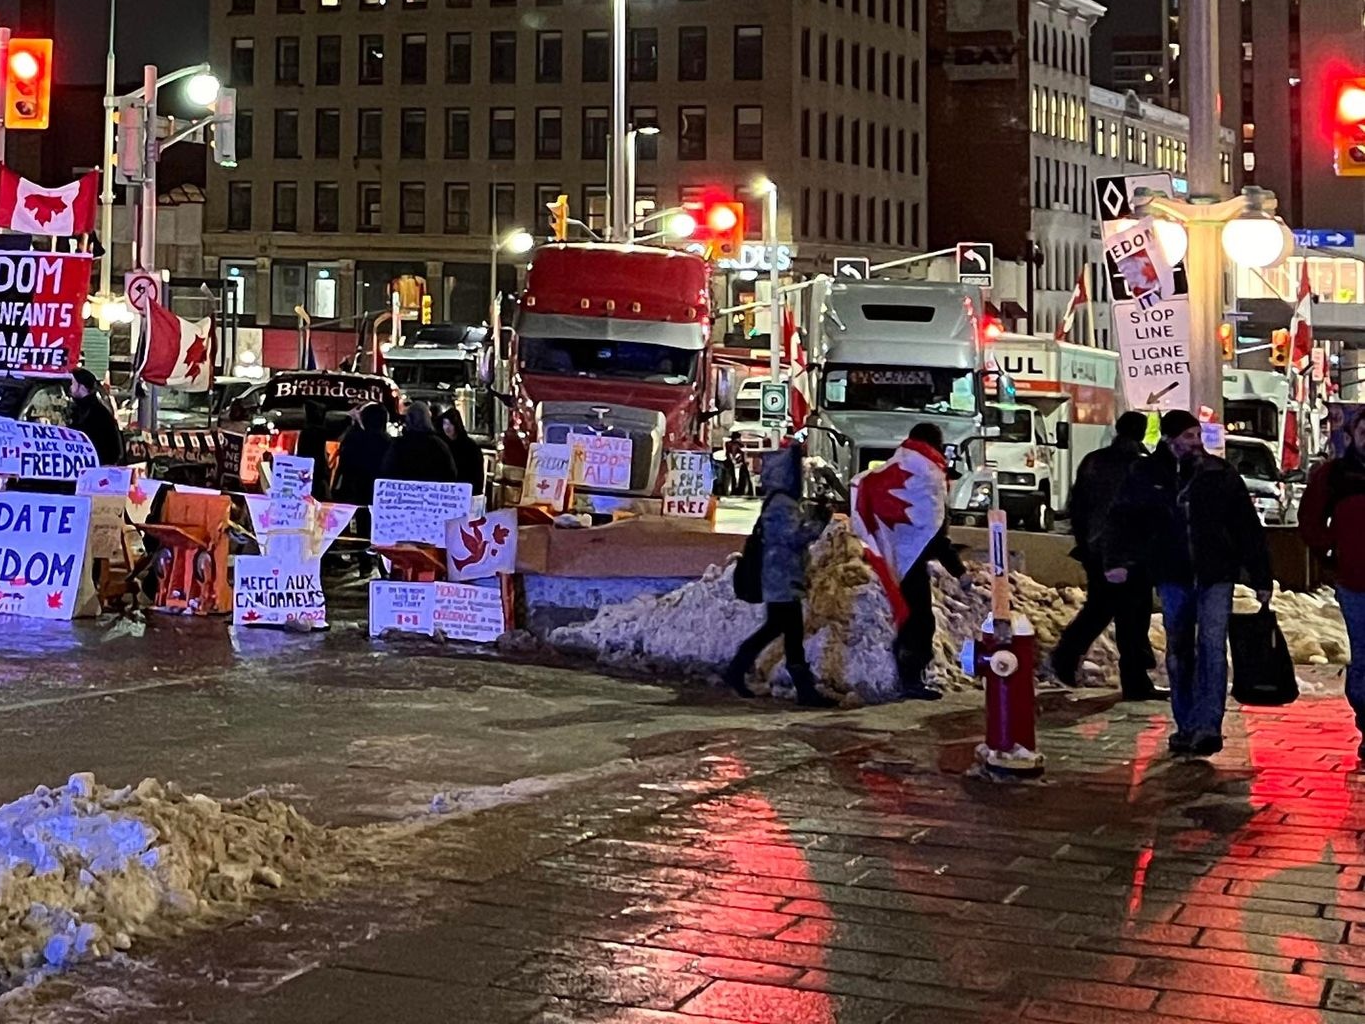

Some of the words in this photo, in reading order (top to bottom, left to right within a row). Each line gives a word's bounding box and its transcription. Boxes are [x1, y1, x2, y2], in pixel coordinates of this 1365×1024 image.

[1130, 309, 1175, 324] STOP
[1135, 326, 1174, 340] LINE
[1132, 345, 1184, 360] LIGNE
[18, 424, 59, 439] TAKE
[35, 442, 58, 452] BACK
[21, 453, 97, 477] FREEDOM
[286, 574, 316, 590] AUX
